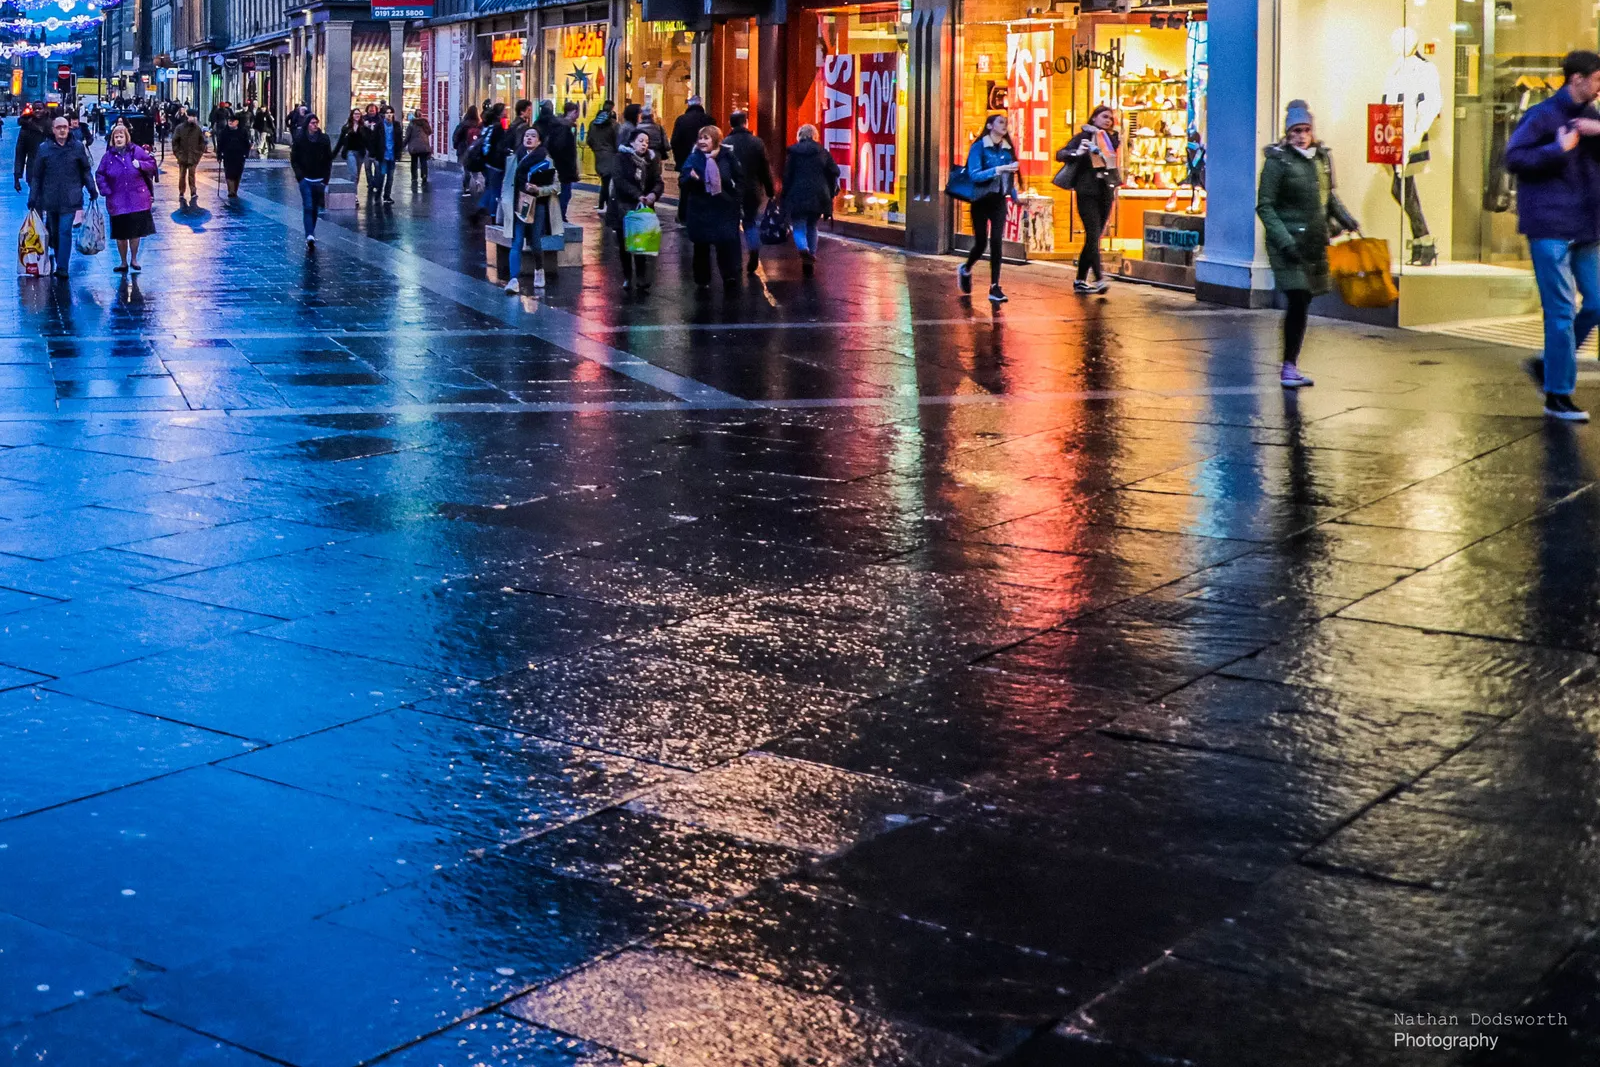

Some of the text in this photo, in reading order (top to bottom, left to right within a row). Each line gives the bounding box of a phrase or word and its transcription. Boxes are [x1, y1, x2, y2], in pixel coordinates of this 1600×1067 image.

[858, 71, 896, 134] 50%
[1374, 124, 1395, 143] 60
[859, 142, 895, 194] OFF
